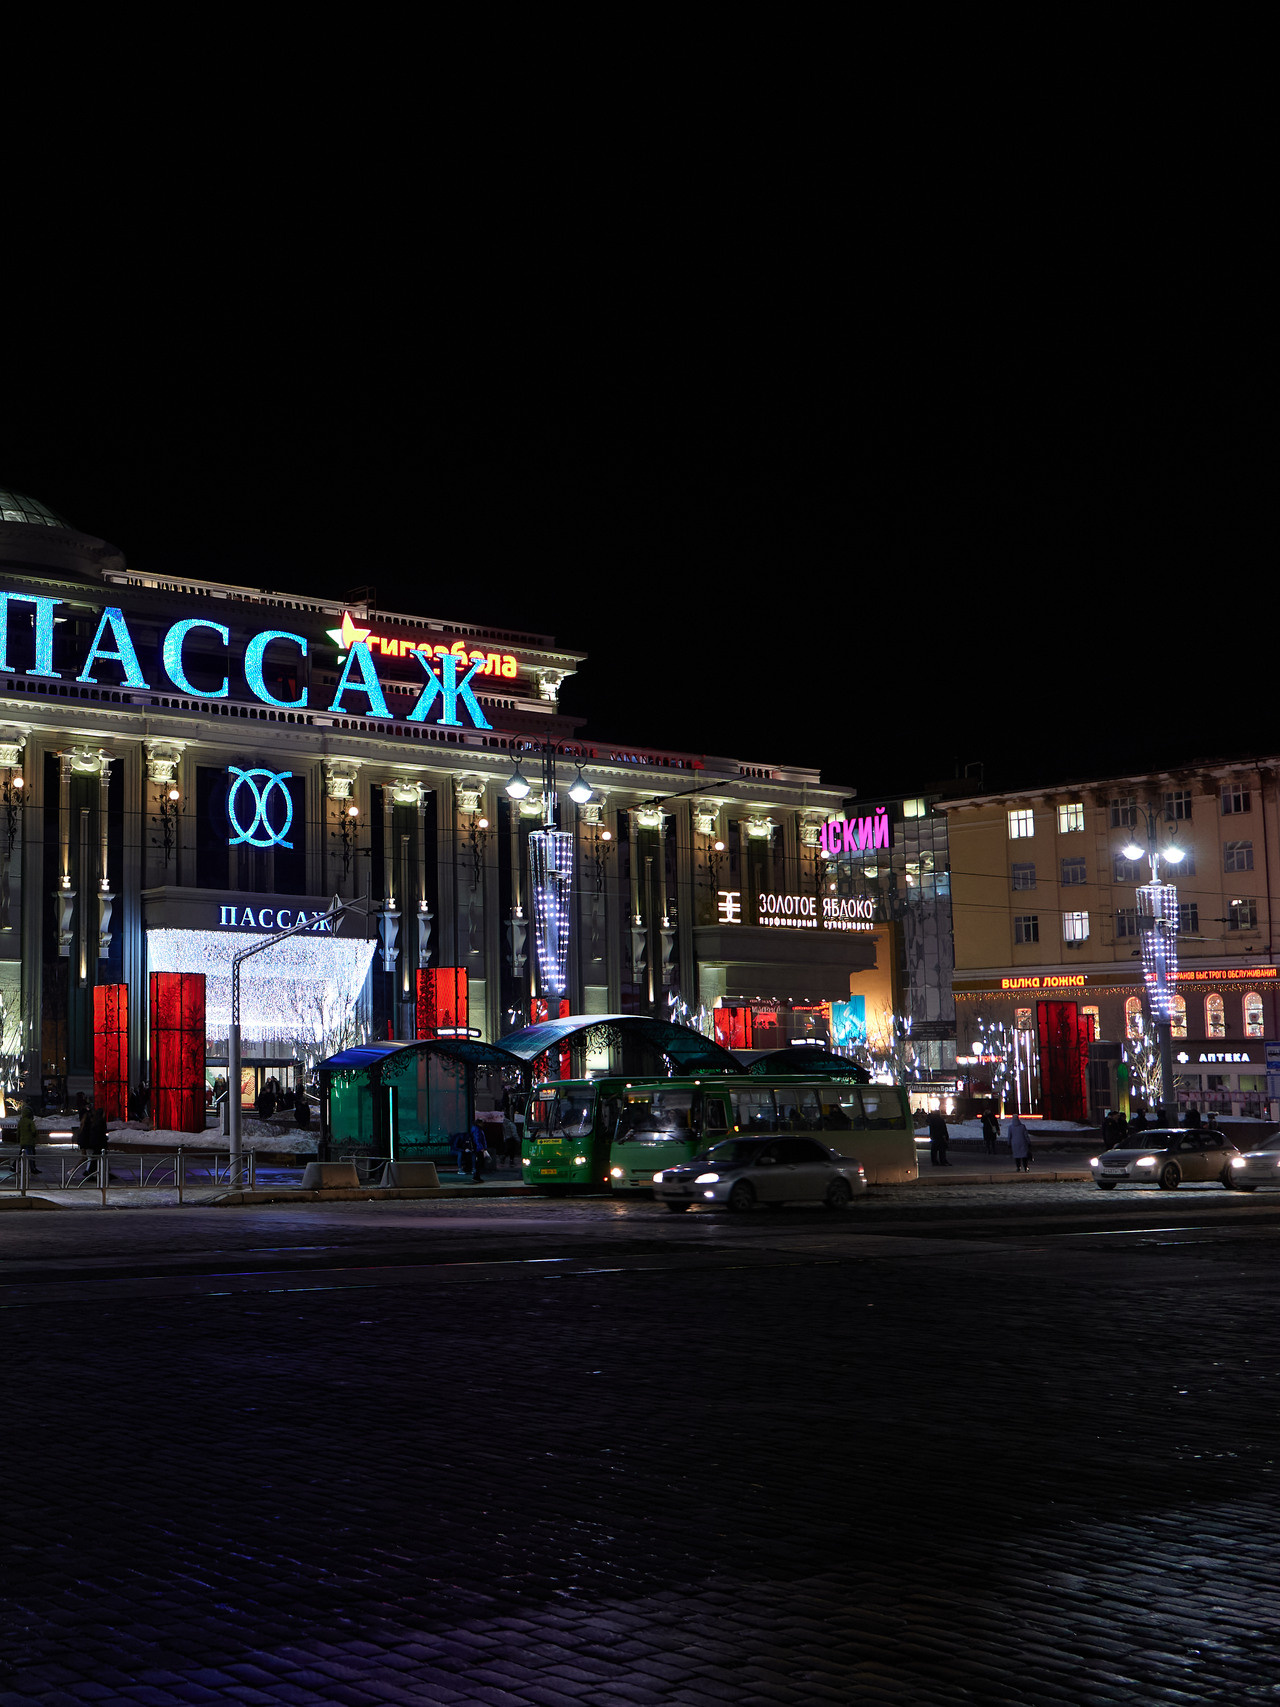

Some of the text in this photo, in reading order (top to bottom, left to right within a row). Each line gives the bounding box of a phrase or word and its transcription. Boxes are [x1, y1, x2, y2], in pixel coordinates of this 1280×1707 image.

[759, 893, 873, 919] ЗОЛОТОЕ ЯБЛОКО
[219, 905, 332, 931] ПАССАЖ
[759, 916, 874, 931] парфюмерный супермаркет
[1195, 969, 1227, 981] БЫСТРОГО
[1227, 968, 1277, 979] ОБСЛУЖИВАНИЯ
[1198, 1052, 1251, 1063] АПТЕКА
